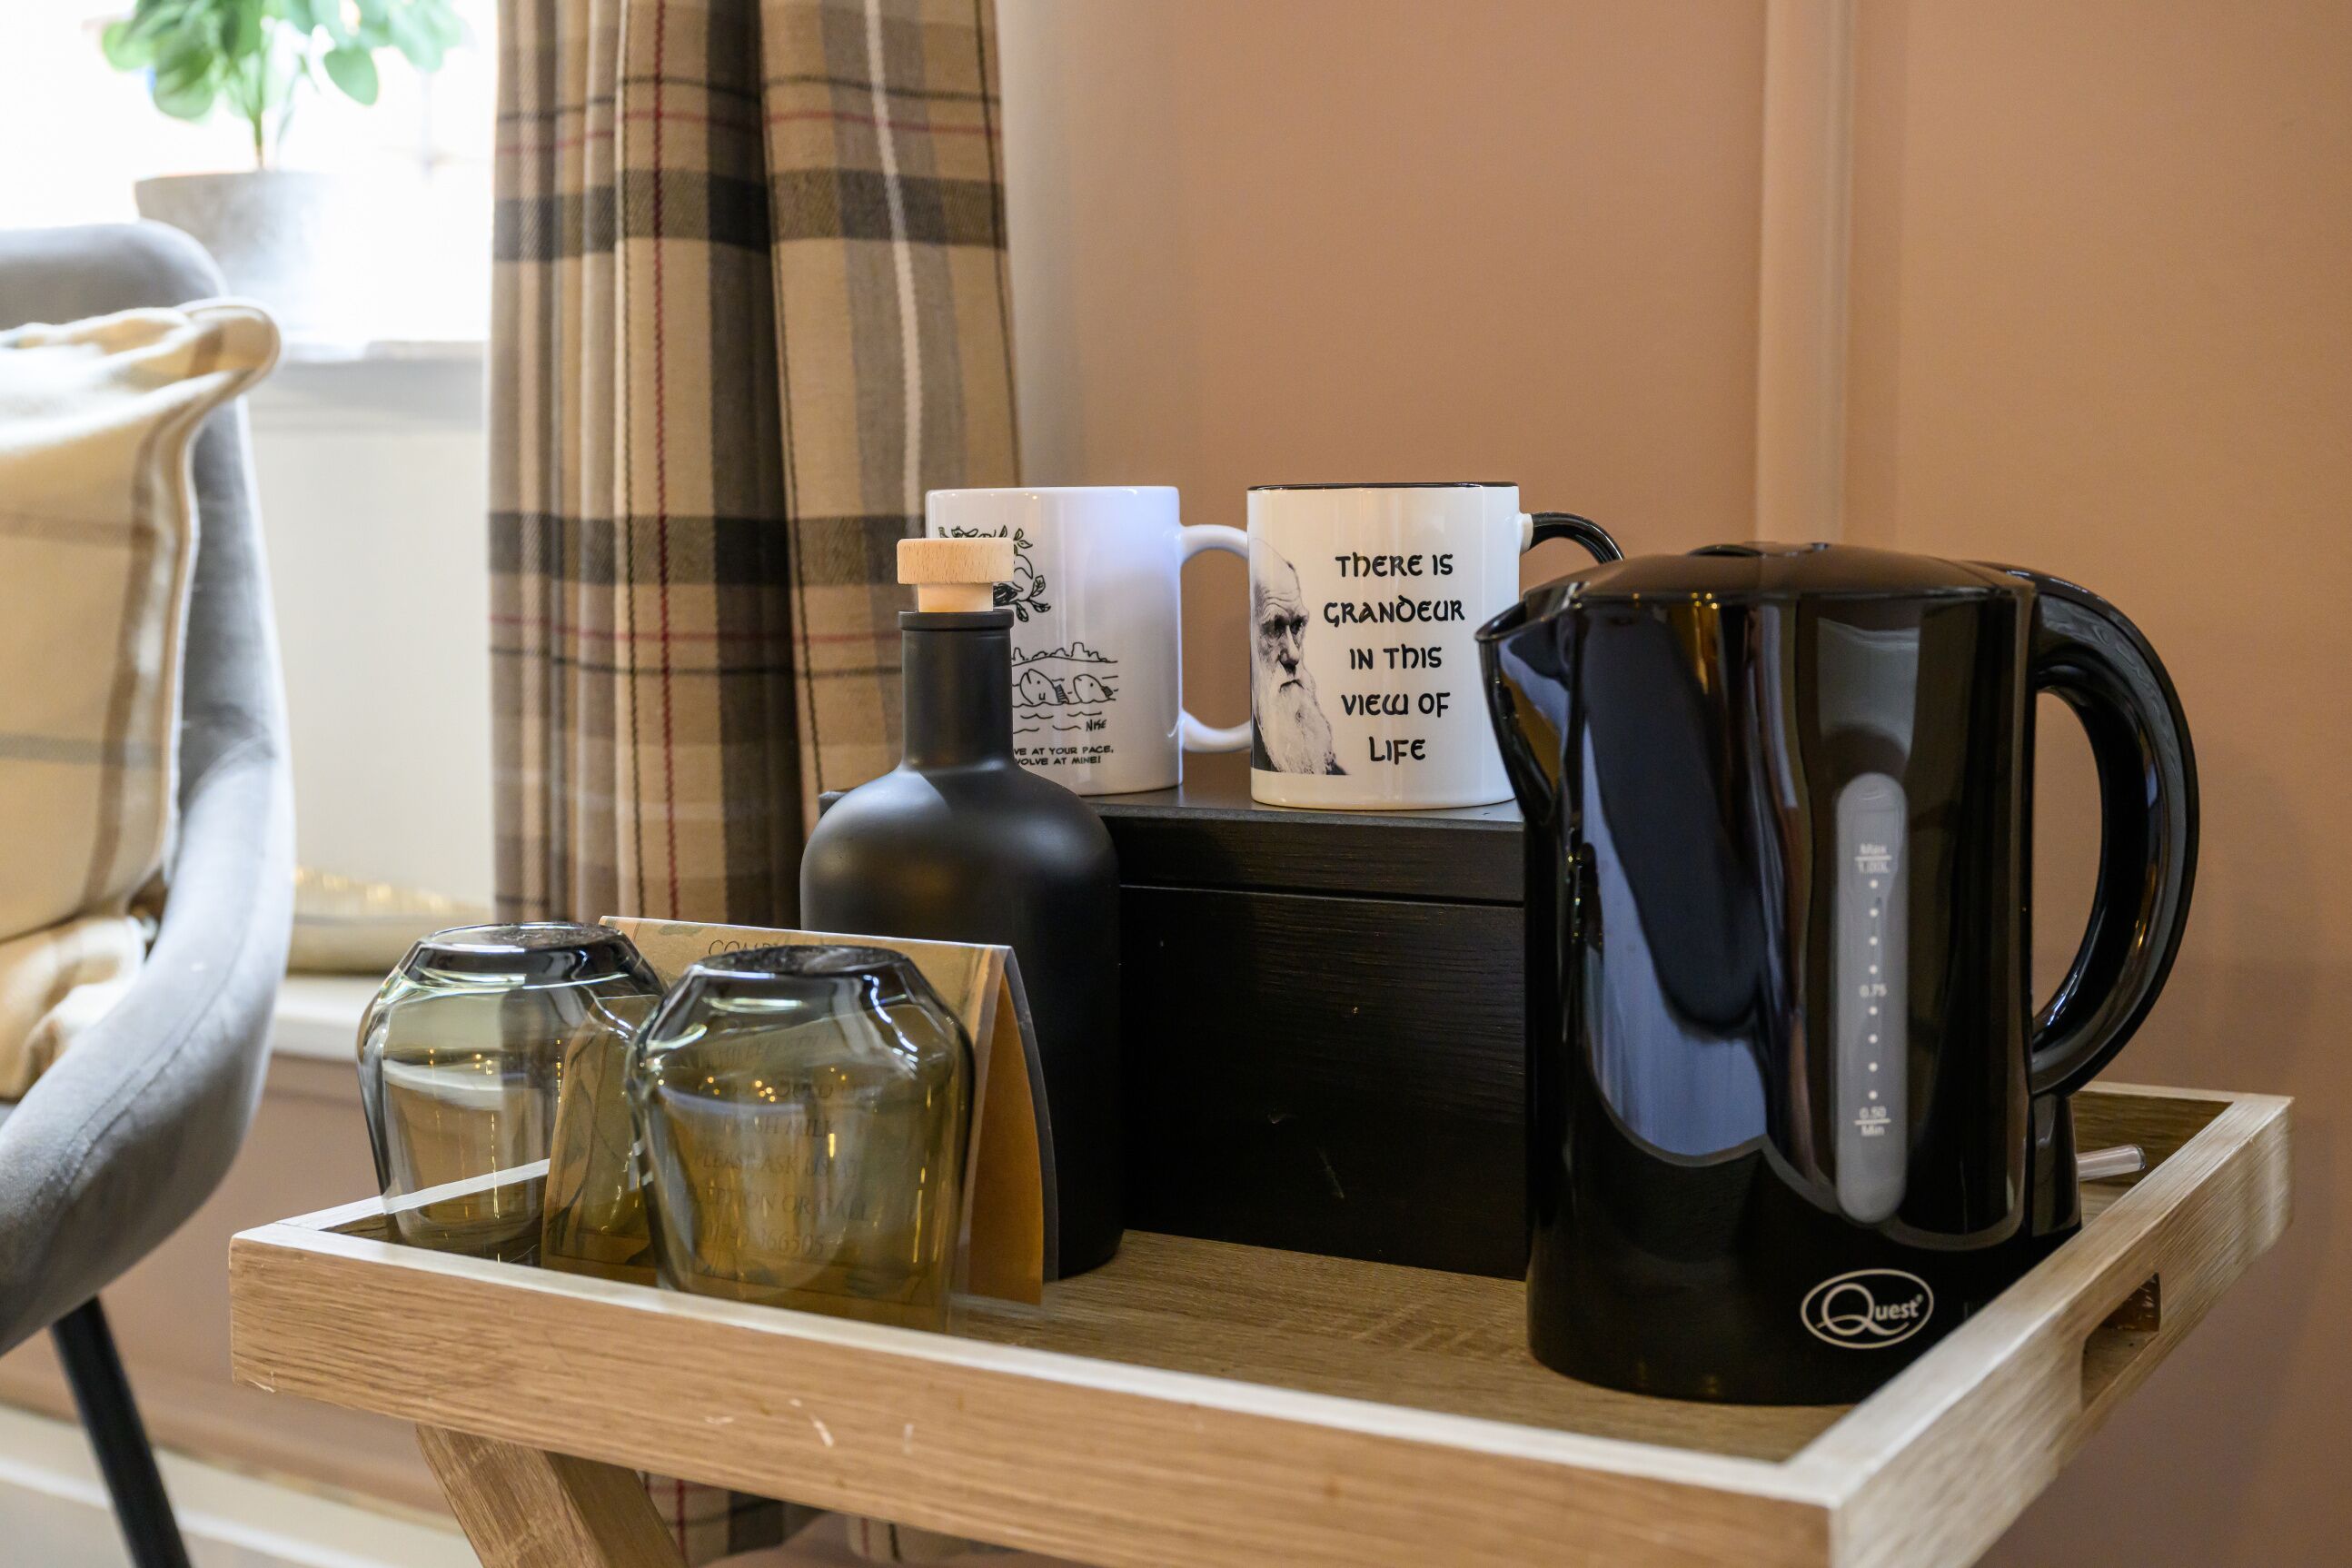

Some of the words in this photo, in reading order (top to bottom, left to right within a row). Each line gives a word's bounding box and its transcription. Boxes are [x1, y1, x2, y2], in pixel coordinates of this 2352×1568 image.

[1335, 551, 1423, 577] THERE
[1433, 553, 1454, 576] IS
[1324, 594, 1465, 628] GRANDEUR
[1349, 648, 1374, 670] IN
[1383, 643, 1442, 669] THIS
[1341, 693, 1409, 716] VIEW
[1418, 691, 1451, 718] OF
[1016, 758, 1048, 766] VOLVE
[1053, 757, 1067, 765] AT
[1072, 756, 1102, 764] MINE!
[1031, 748, 1046, 756] AT
[1049, 746, 1077, 756] YOUR
[1082, 745, 1115, 754] PACE,
[1368, 736, 1425, 765] LIFE
[1816, 1282, 1920, 1336] Quest
